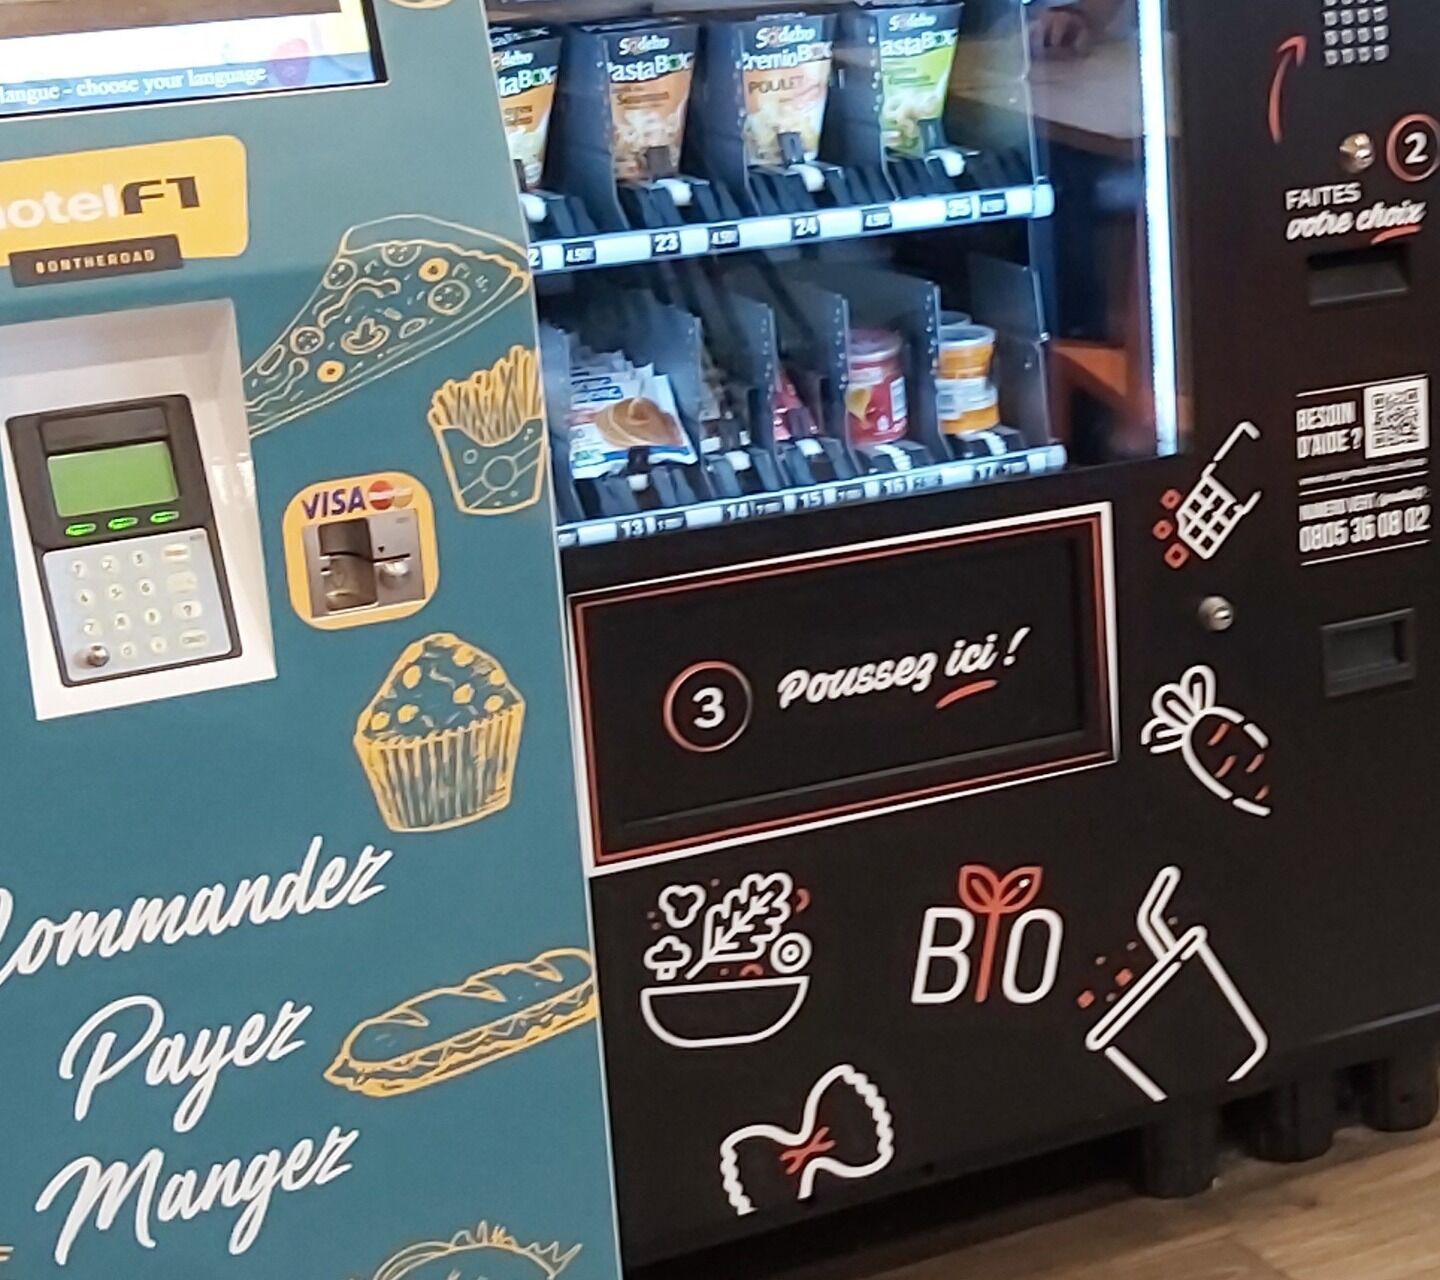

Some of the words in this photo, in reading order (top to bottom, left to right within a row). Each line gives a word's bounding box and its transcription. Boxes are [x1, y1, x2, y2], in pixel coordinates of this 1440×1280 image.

[76, 78, 140, 97] choose
[143, 73, 185, 95] your
[188, 66, 267, 87] language
[749, 75, 804, 94] POULET
[1404, 131, 1429, 164] 2
[1285, 182, 1362, 210] FAITES
[795, 216, 818, 236] 24
[1286, 210, 1354, 240] votre
[655, 233, 679, 252] 23
[1296, 401, 1356, 432] BESOIN
[301, 486, 367, 519] VISA
[727, 502, 749, 521] 14
[800, 491, 823, 508] 15
[621, 519, 644, 536] 13
[1300, 519, 1350, 553] 0805
[1377, 510, 1404, 538] 08
[1404, 504, 1431, 533] 02
[778, 652, 934, 709] Poussez
[944, 632, 998, 678] ici
[692, 687, 727, 729] 3
[910, 866, 1064, 1004] BIO
[58, 994, 313, 1133] Payez
[35, 1127, 360, 1266] Mangez
